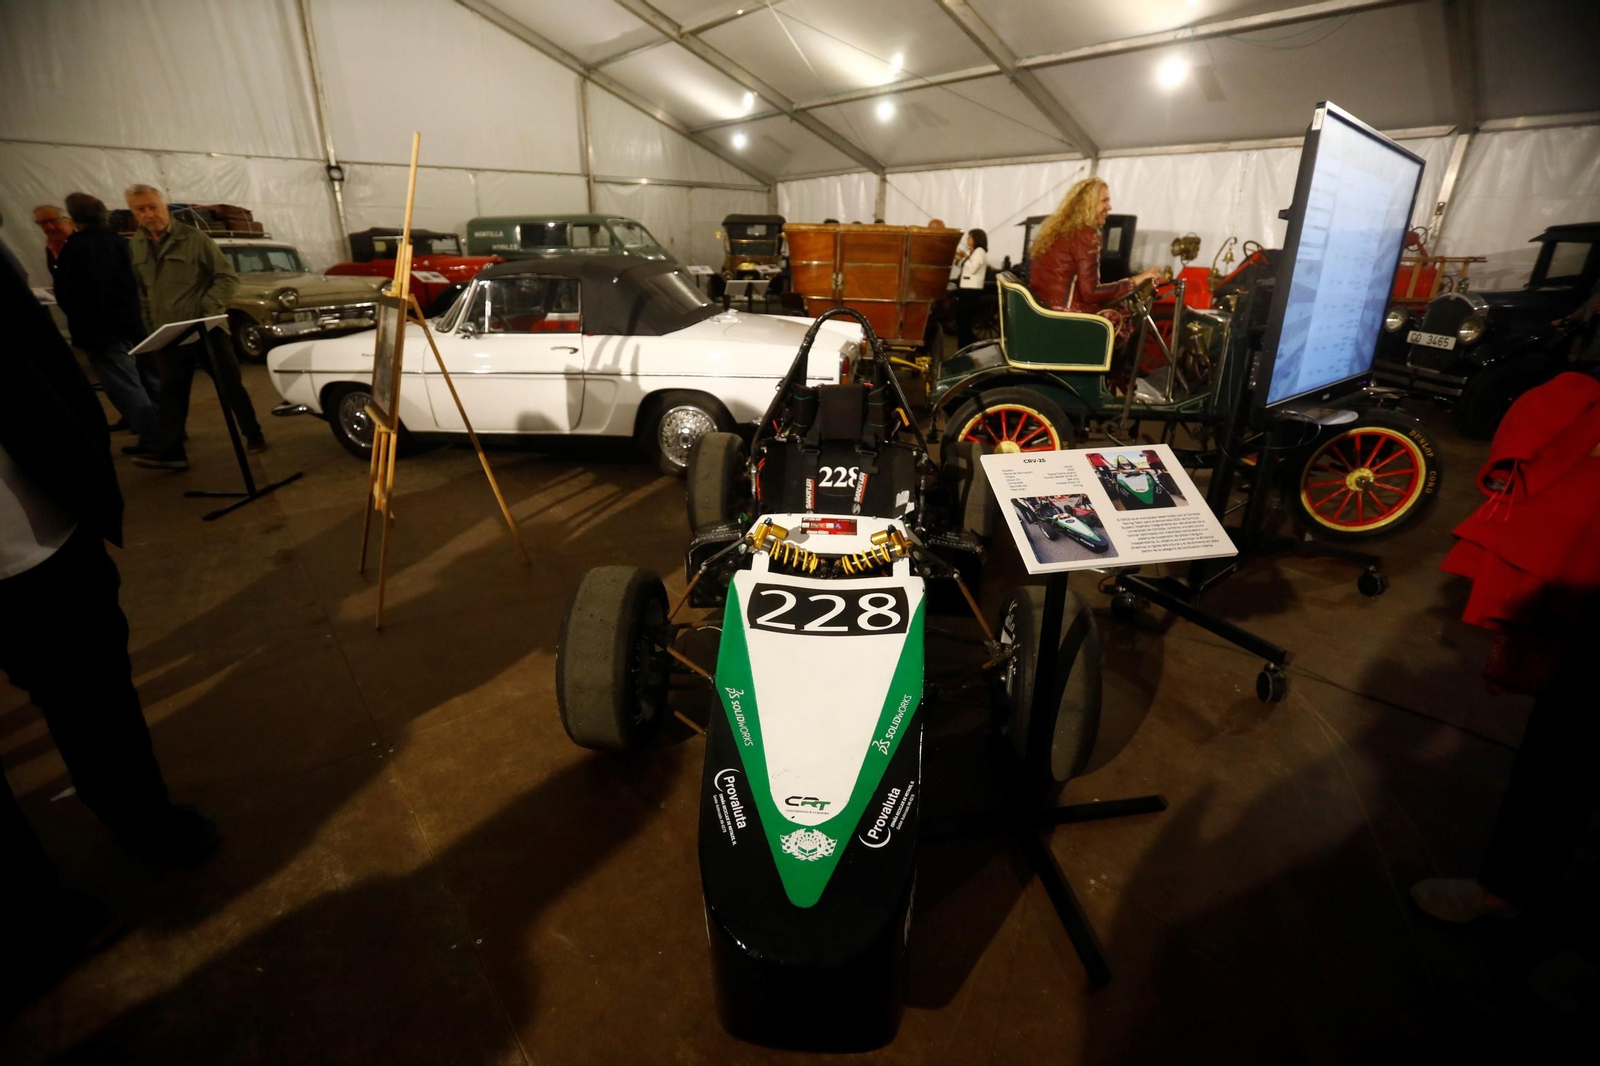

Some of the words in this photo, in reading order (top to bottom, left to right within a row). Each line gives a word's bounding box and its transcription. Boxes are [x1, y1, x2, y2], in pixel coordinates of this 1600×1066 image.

[1426, 334, 1449, 348] 3465
[818, 466, 860, 488] 228
[1409, 430, 1434, 458] DUNLOP
[1426, 470, 1437, 493] CORD
[756, 590, 900, 632] 228
[732, 701, 753, 746] SOLIDWORKS
[886, 694, 912, 739] SOLIDWORKS
[724, 776, 746, 828] Provaluta
[785, 796, 831, 810] CRT
[868, 788, 900, 839] Provaluta
